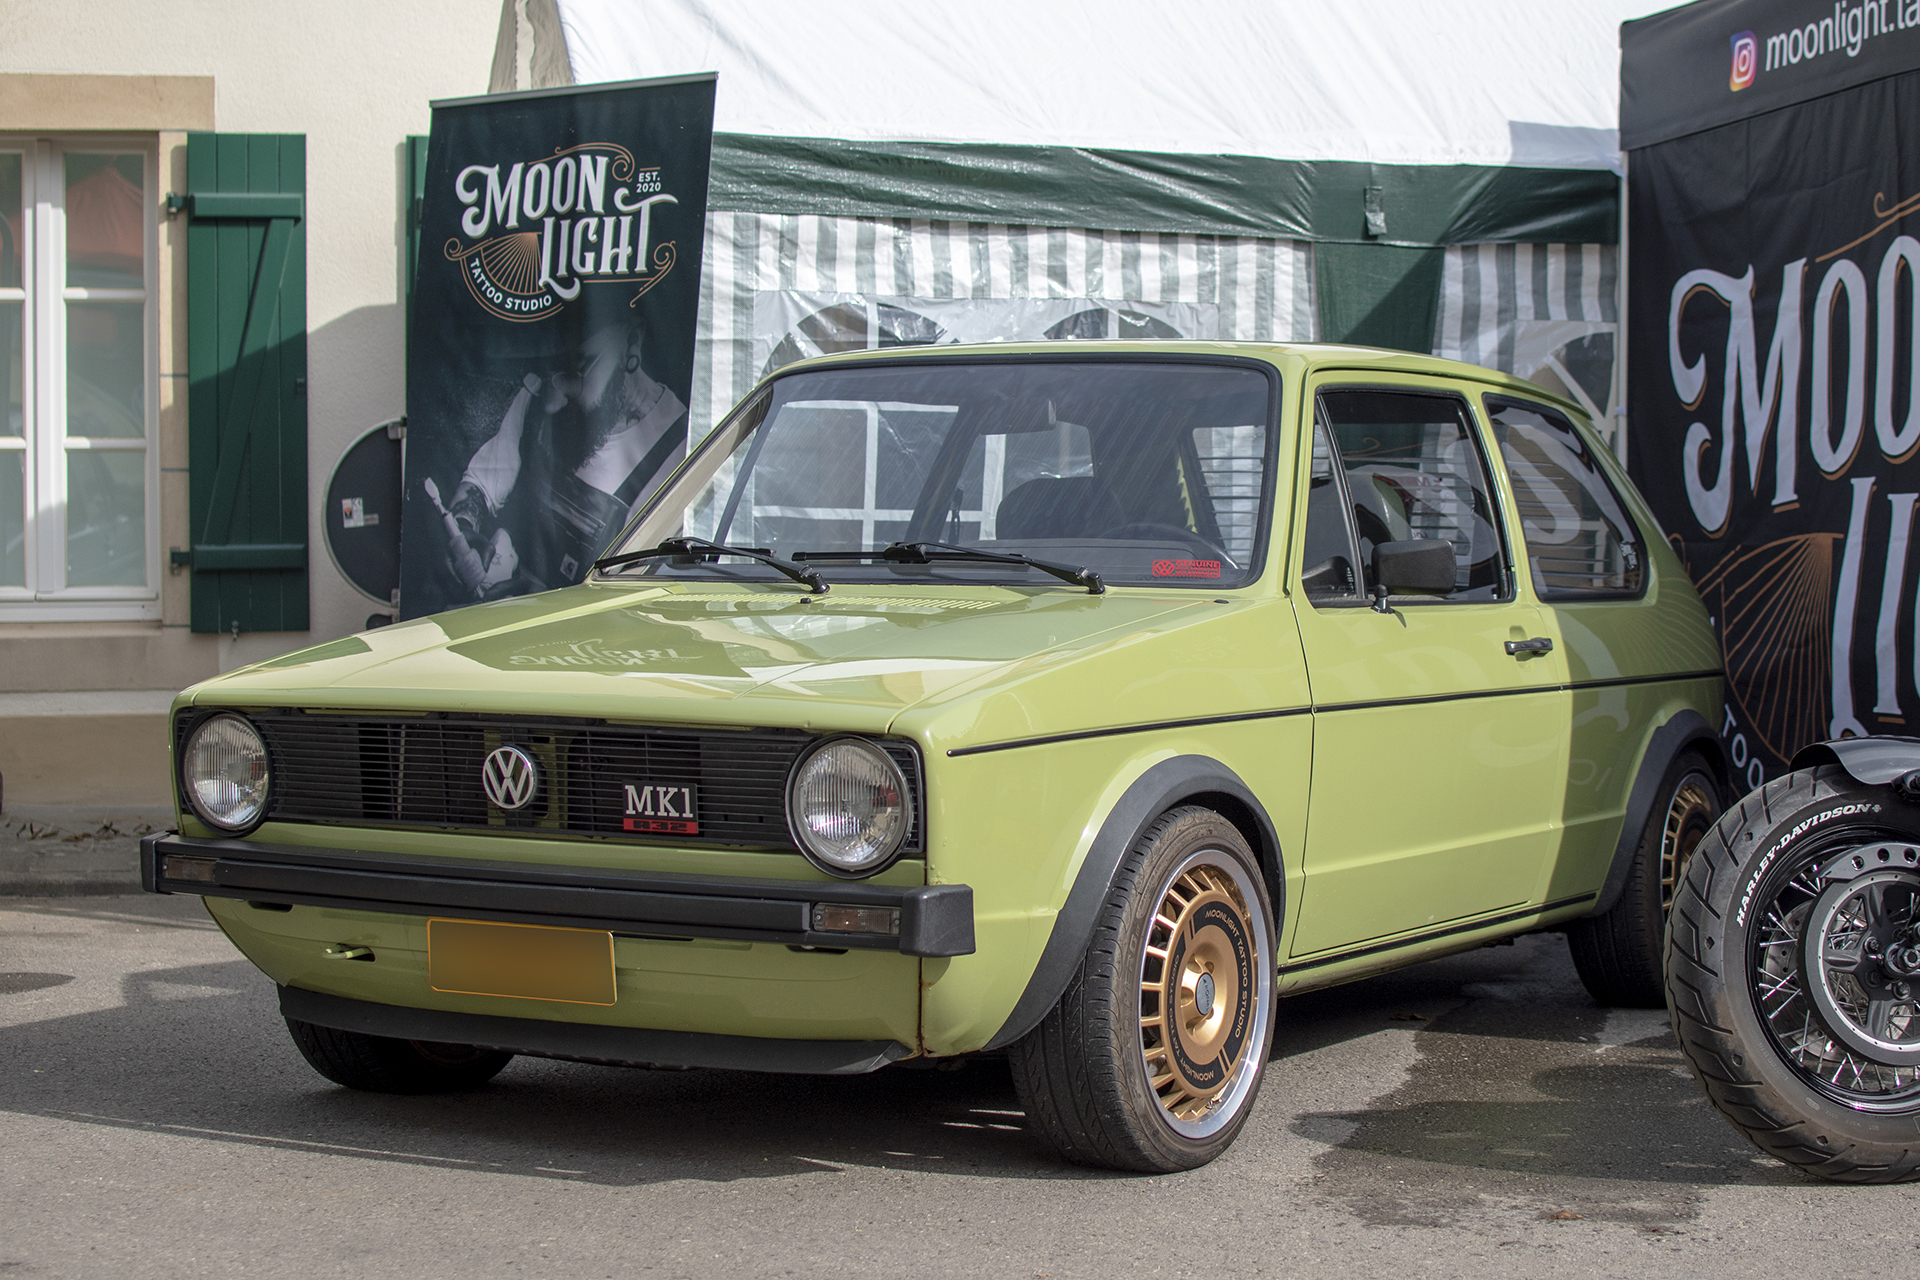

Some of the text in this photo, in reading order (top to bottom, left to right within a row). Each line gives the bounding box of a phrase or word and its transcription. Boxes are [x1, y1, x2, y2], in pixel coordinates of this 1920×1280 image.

[636, 182, 661, 193] 2020
[638, 171, 660, 182] EST.
[455, 155, 609, 238] MOON
[538, 187, 679, 300] LIGHT
[470, 257, 552, 312] TATTOO STUDIO
[1175, 560, 1218, 568] GENUINE
[1829, 476, 1920, 740] LI
[624, 784, 694, 818] MK1
[633, 820, 688, 832] R32
[1205, 909, 1248, 1038] MOONLIGHT TATTOO STUDIO
[1180, 1057, 1214, 1081] MOONLIGHT
